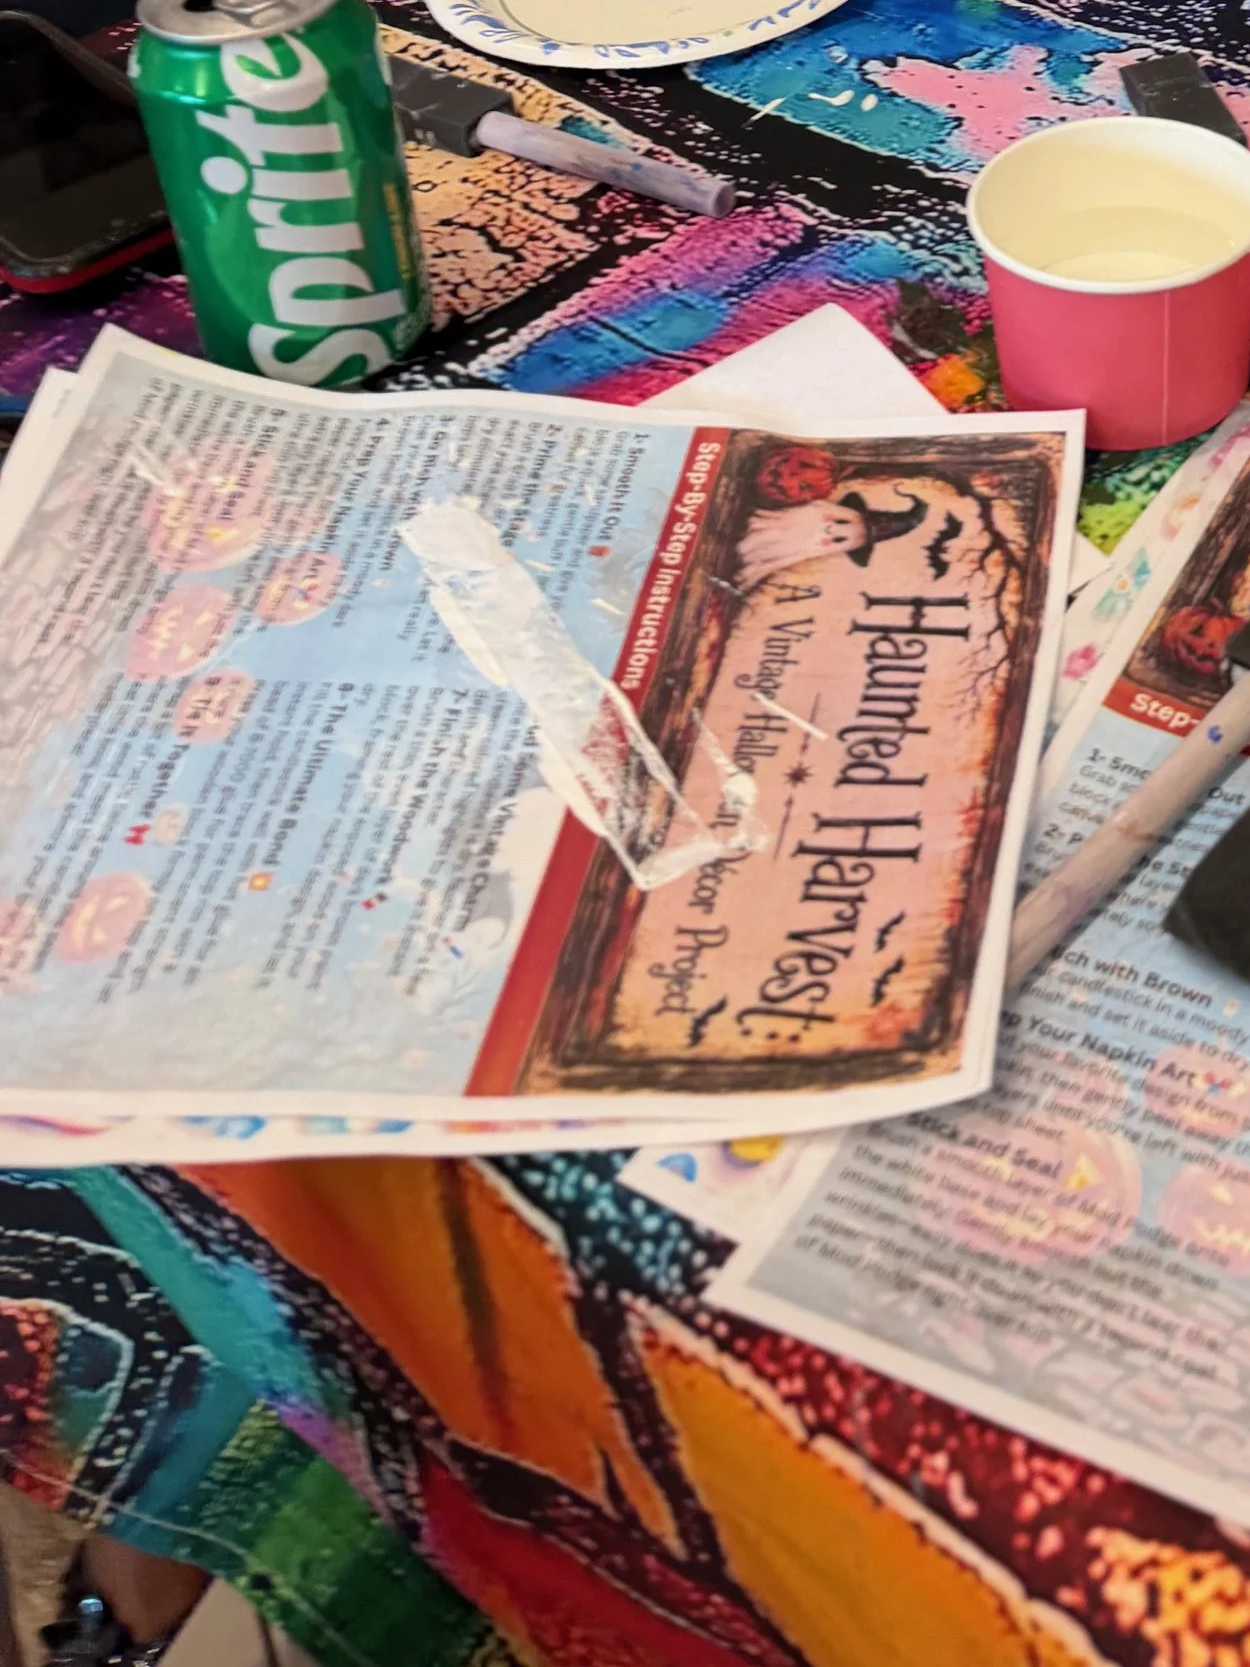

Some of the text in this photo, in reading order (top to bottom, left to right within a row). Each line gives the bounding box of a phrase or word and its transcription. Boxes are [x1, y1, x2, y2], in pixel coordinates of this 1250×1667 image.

[195, 33, 407, 386] Sprite
[340, 469, 368, 501] Your
[528, 439, 557, 479] Prime
[611, 446, 644, 499] Smooth
[316, 504, 353, 554] Napkin
[596, 514, 619, 541] Out
[619, 441, 722, 690] Step-By-Step Instructions
[733, 617, 816, 706] Vintage
[320, 702, 348, 734] The
[139, 742, 189, 819] Together
[284, 738, 334, 814] Ultimate
[414, 761, 440, 789] the
[502, 751, 534, 798] Some
[375, 792, 427, 885] Woodwork
[735, 590, 973, 1043] Haunted Harvest:
[452, 870, 490, 932] Charm
[646, 925, 728, 1018] Project
[1092, 957, 1214, 1008] with Brown
[1026, 1013, 1198, 1085] Your Napkin Art
